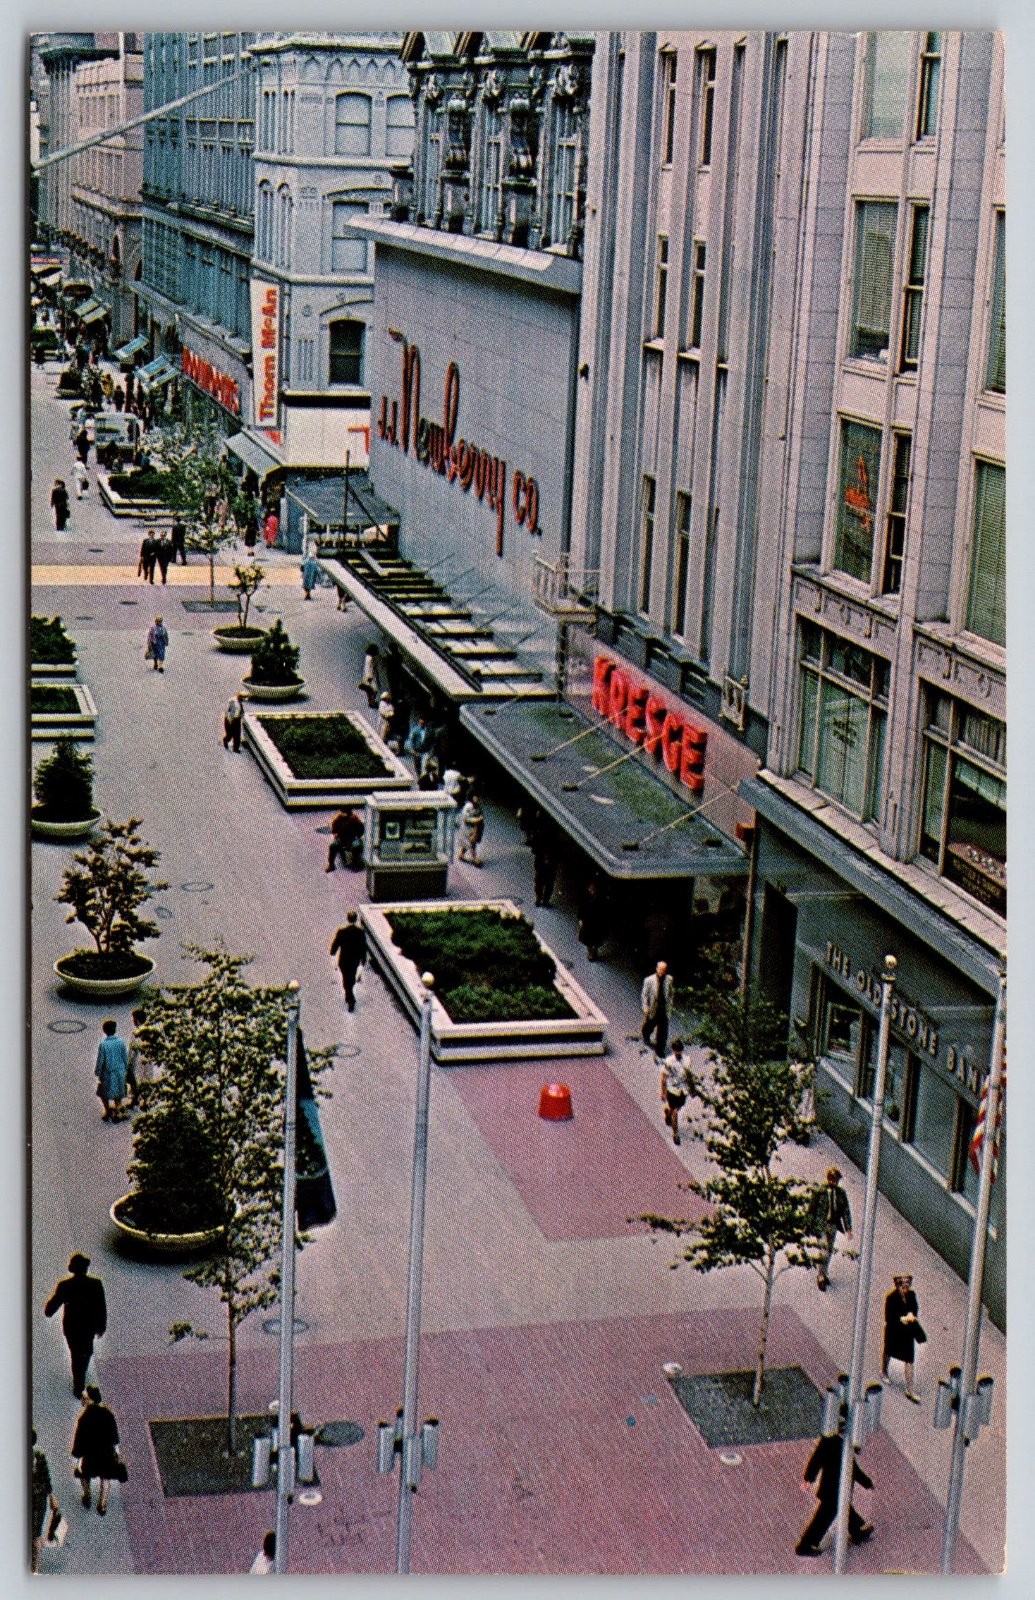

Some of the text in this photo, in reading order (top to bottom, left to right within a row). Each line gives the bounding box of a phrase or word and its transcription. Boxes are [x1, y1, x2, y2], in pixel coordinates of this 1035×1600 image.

[259, 353, 277, 422] Thom
[827, 940, 850, 978] THE
[947, 1044, 986, 1094] BAN
